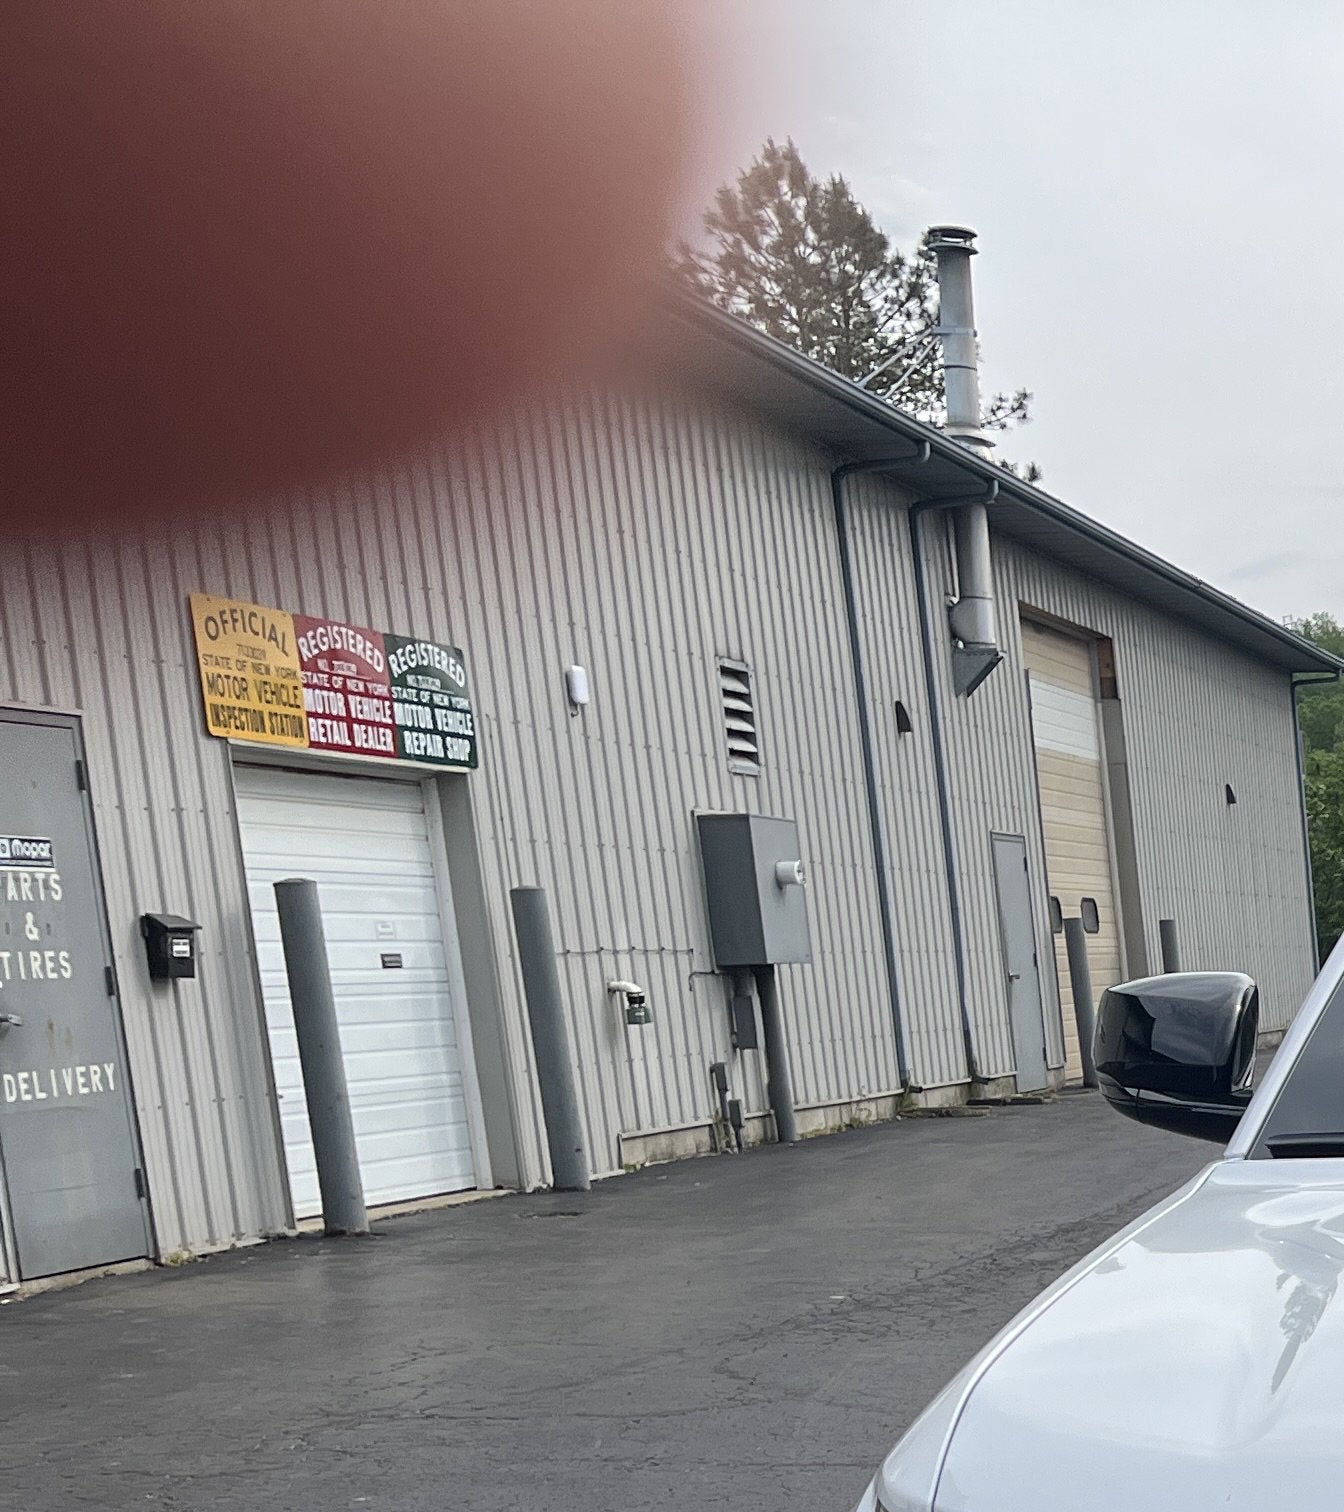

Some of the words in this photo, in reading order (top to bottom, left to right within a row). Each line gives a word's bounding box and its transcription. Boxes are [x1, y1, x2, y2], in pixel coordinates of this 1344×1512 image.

[204, 609, 289, 657] OFFICIAL
[298, 625, 385, 673] REGISTERED
[202, 653, 232, 670] STATE
[235, 659, 247, 672] OF
[388, 642, 466, 688] REGISTERED
[205, 671, 250, 701] MOTOR
[253, 679, 301, 709] VEHICLE
[301, 671, 330, 687] STATE
[332, 676, 344, 689] OF
[392, 686, 418, 702] STATE
[419, 690, 431, 703] OF
[210, 703, 267, 733] INSPECTION
[268, 711, 305, 738] STATION
[303, 687, 347, 717] MOTOR
[347, 694, 393, 724] VEHICLE
[393, 703, 434, 730] MOTOR
[434, 707, 474, 736] VEHICLE
[308, 717, 352, 746] RETAIL
[352, 723, 394, 752] DEALER
[403, 730, 445, 758] REPAIR
[445, 736, 471, 761] SHOP
[0, 872, 63, 902] ARTS
[25, 911, 41, 941] &
[0, 950, 73, 980] TIRES
[2, 1062, 115, 1103] DELIVERY
